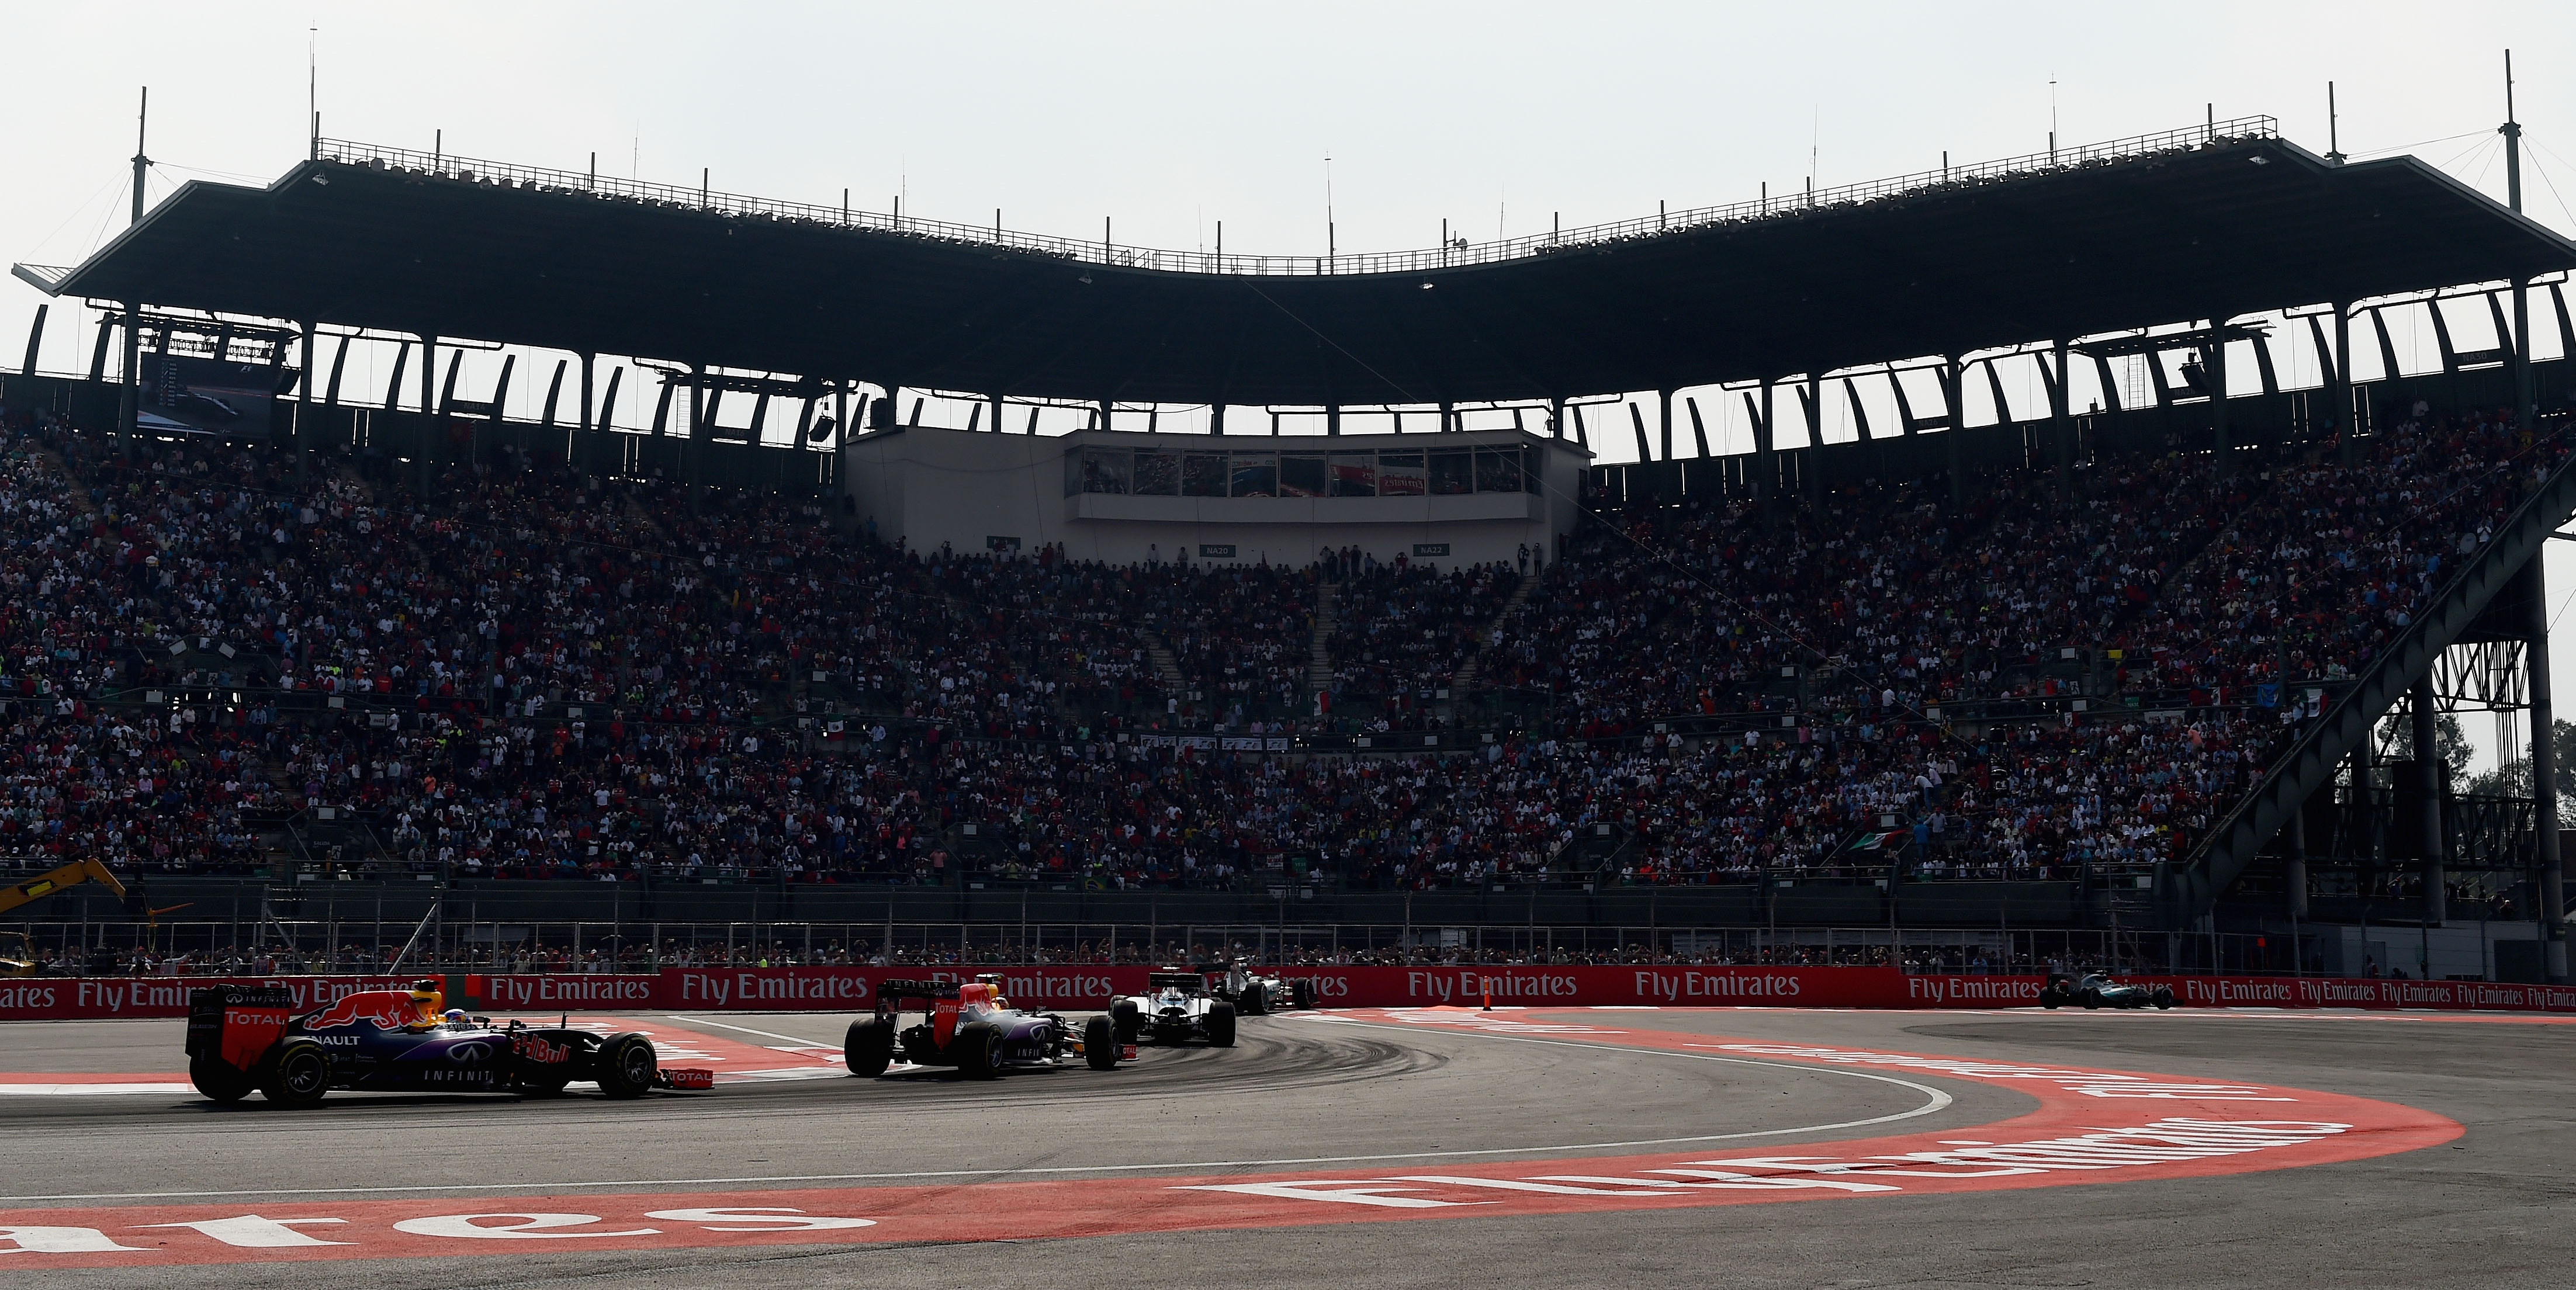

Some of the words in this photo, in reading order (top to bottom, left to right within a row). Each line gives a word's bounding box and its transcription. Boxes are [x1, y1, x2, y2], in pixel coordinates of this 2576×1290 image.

[2463, 352, 2487, 362] NA30
[1206, 547, 1228, 555] NA20
[1420, 545, 1443, 554] NA22
[0, 984, 55, 1008] ates
[78, 982, 123, 1012] Fly
[130, 981, 209, 1006] Emir
[491, 977, 533, 1005] Fly
[539, 976, 650, 1000] Emirates
[683, 973, 730, 1005] Fly
[738, 972, 868, 999] Emirates
[1408, 971, 1453, 1002] Fly
[1459, 970, 1577, 996] Emirates
[1635, 971, 1679, 1001] Fly
[1685, 970, 1800, 996] Emirates
[1909, 978, 1944, 1003] Fly
[1949, 977, 2041, 998] Emirates
[2186, 979, 2216, 1004] Fly
[2220, 979, 2292, 1001] Emirates
[2298, 979, 2321, 1004] Fly
[2322, 980, 2376, 1001] Emirates
[2381, 982, 2401, 1006] Fly
[2402, 982, 2451, 1003] Emirates
[2457, 983, 2476, 1008] Fly
[2478, 984, 2524, 1005] Emirates
[935, 1001, 958, 1014] TOTAL
[2527, 987, 2544, 1010] Fly
[224, 1011, 285, 1025] TOTAL
[534, 1038, 572, 1064] Bull
[671, 1071, 713, 1081] TOTAL
[1162, 1169, 1902, 1209] Fly
[1674, 1116, 2355, 1178] Emirates
